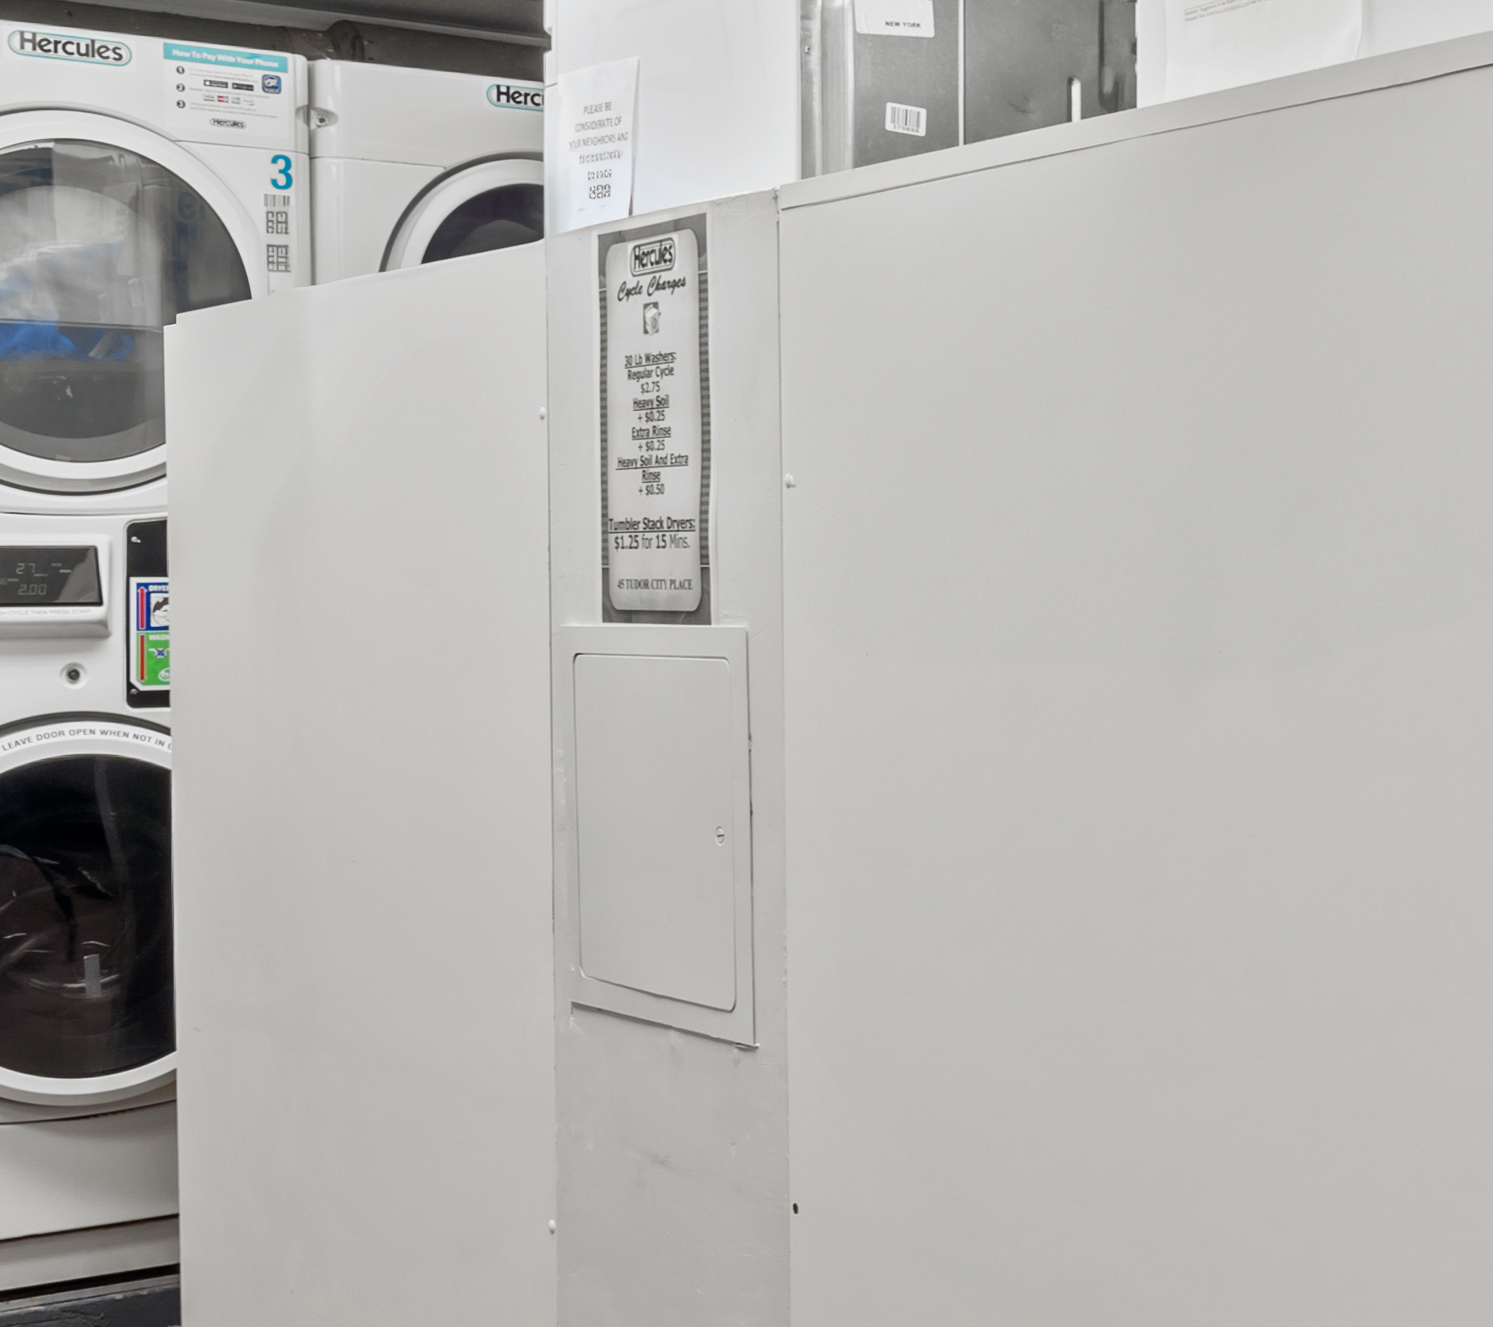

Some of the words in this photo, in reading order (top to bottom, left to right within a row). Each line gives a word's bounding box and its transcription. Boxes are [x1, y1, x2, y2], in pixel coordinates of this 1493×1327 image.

[903, 21, 921, 29] YORK
[18, 31, 123, 62] Hercules
[171, 49, 191, 58] How
[191, 51, 201, 59] To
[202, 52, 216, 62] Pay
[217, 54, 236, 63] With
[236, 56, 254, 65] Your
[254, 58, 279, 68] Phone
[496, 84, 544, 106] Herc
[583, 103, 603, 114] PLEASE
[605, 102, 612, 111] BE
[575, 118, 613, 132] CONSIDERATE
[614, 116, 622, 126] OF
[270, 154, 293, 190] 3
[634, 240, 673, 269] Hercules
[617, 280, 643, 302] Cycle
[647, 275, 686, 296] Charges
[624, 355, 633, 366] 30
[634, 354, 642, 365] Lb
[644, 351, 676, 363] Washers:
[627, 368, 653, 382] Regular
[655, 365, 674, 380] Cycle
[641, 381, 660, 394] $2.75
[633, 397, 654, 409] Heavy
[656, 394, 669, 407] Soil
[645, 410, 665, 423] $0.25
[631, 427, 650, 438] Extra
[652, 424, 671, 436] Rinse
[645, 440, 665, 452] $0.25
[617, 457, 638, 468] Heavy
[640, 455, 652, 467] Soil
[655, 454, 668, 465] And
[670, 453, 689, 464] Extra
[642, 469, 661, 481] Rinse
[645, 484, 665, 496] $0.50
[608, 517, 641, 530] Tumbler
[642, 517, 664, 530] Stack
[666, 516, 696, 530] Dryers:
[614, 534, 639, 550] $1.25
[641, 534, 653, 549] for
[656, 534, 667, 549] 15
[669, 534, 691, 548] Mins.
[18, 584, 47, 595] 2.00
[626, 579, 650, 590] TUDOR
[650, 579, 667, 590] CITY
[669, 579, 693, 590] PLACE
[2, 736, 33, 752] LEAVE
[36, 730, 66, 741] DOOR
[68, 728, 96, 737] OPEN
[99, 729, 130, 738] WHEN
[132, 733, 153, 743] NOT
[154, 739, 166, 748] IN
